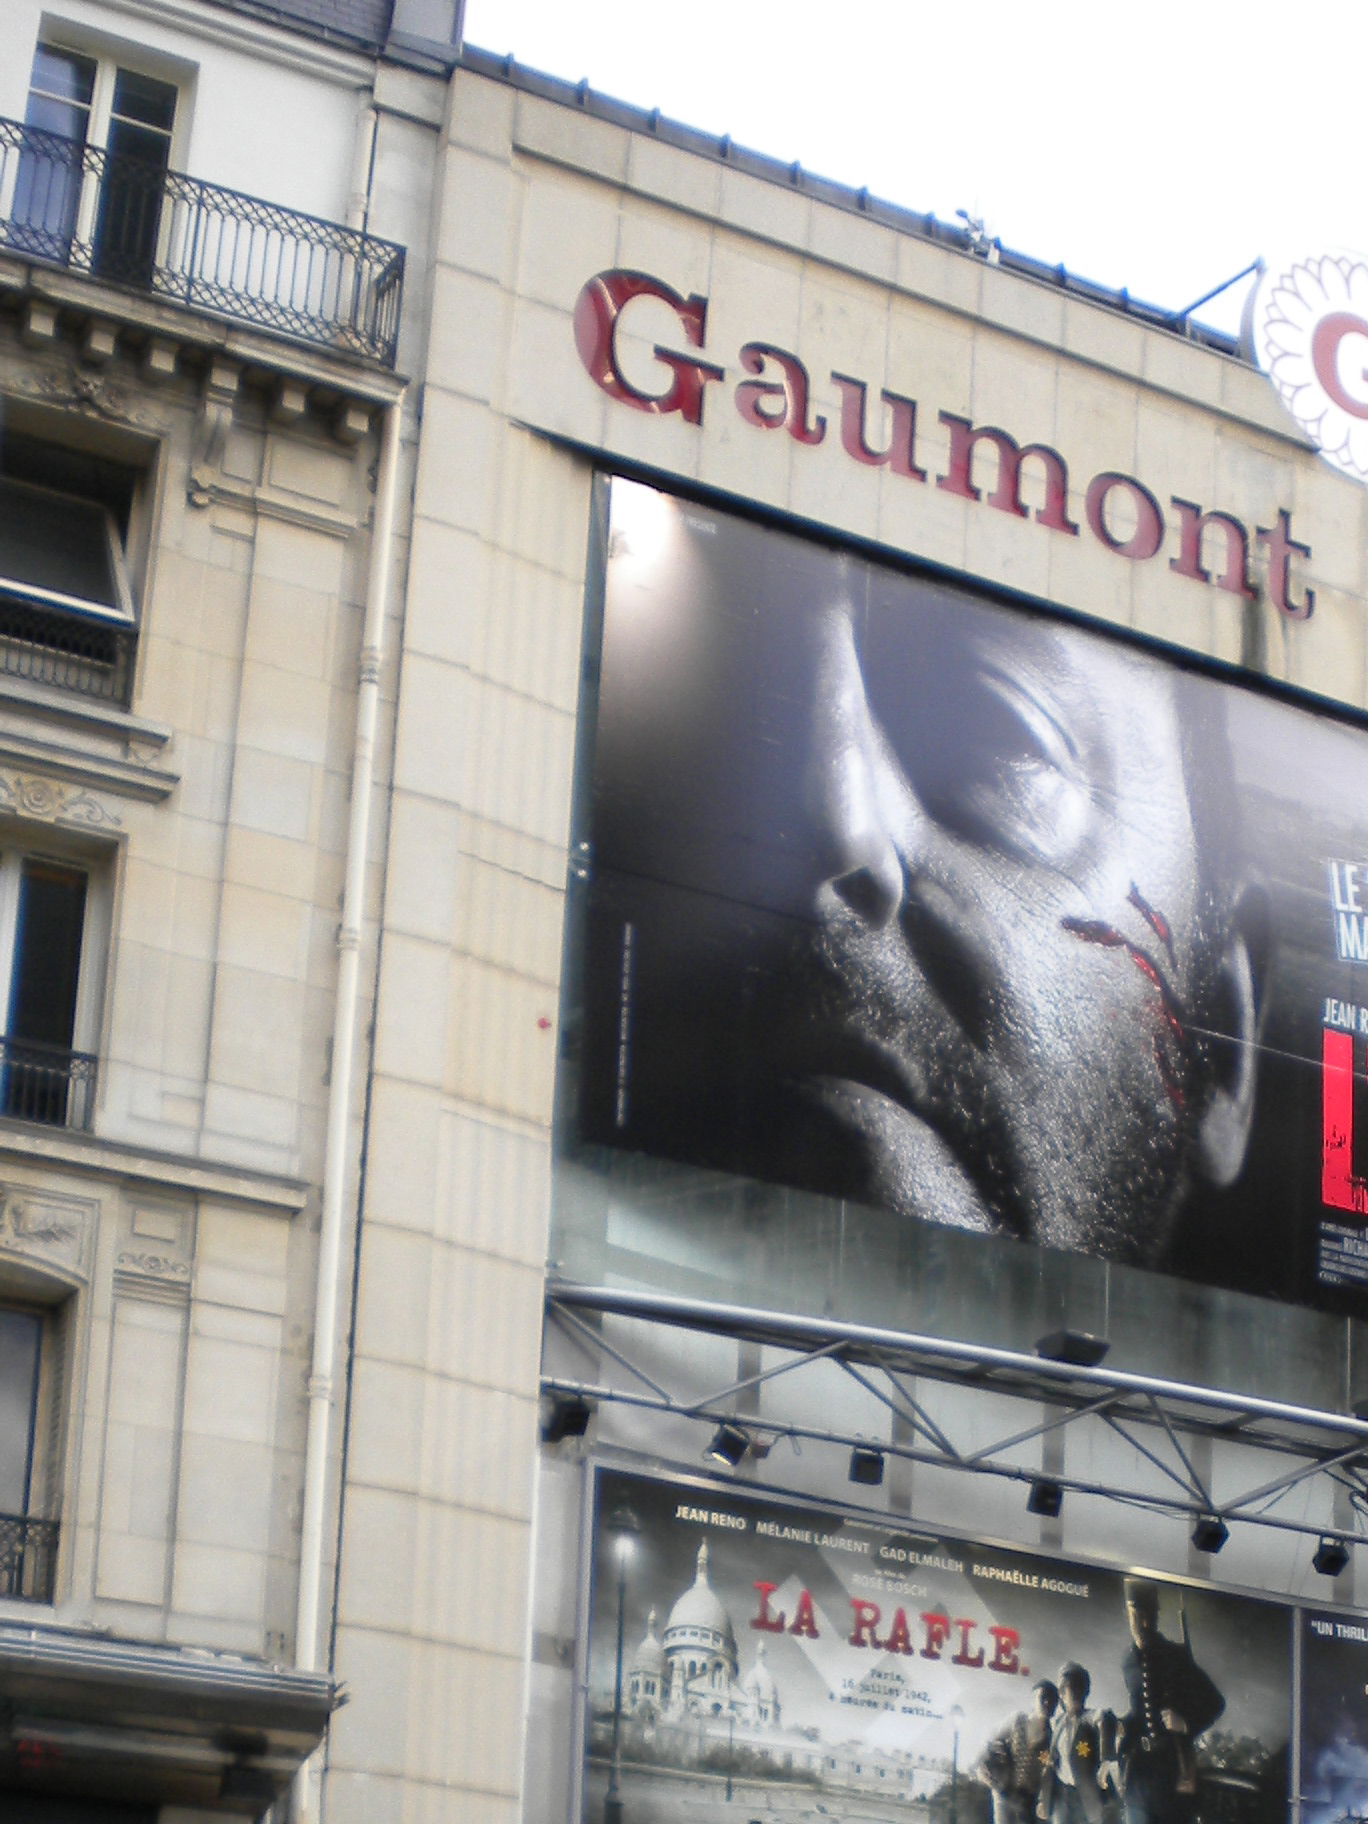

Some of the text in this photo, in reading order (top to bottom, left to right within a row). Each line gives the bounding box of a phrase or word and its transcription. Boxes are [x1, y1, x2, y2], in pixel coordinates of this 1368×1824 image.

[574, 268, 1316, 620] Gaumont
[1331, 861, 1362, 912] LE
[1324, 998, 1355, 1030] JEAN
[675, 1505, 707, 1524] JEAN
[711, 1511, 747, 1530] RENO
[756, 1521, 812, 1543] MÉLANIE
[814, 1532, 870, 1554] LAURENT
[879, 1546, 906, 1563] GAD
[909, 1552, 964, 1573] ELMALEH
[973, 1564, 1039, 1588] RAPHAËLLE
[750, 1581, 820, 1640] LA
[887, 1579, 927, 1597] BOSCH
